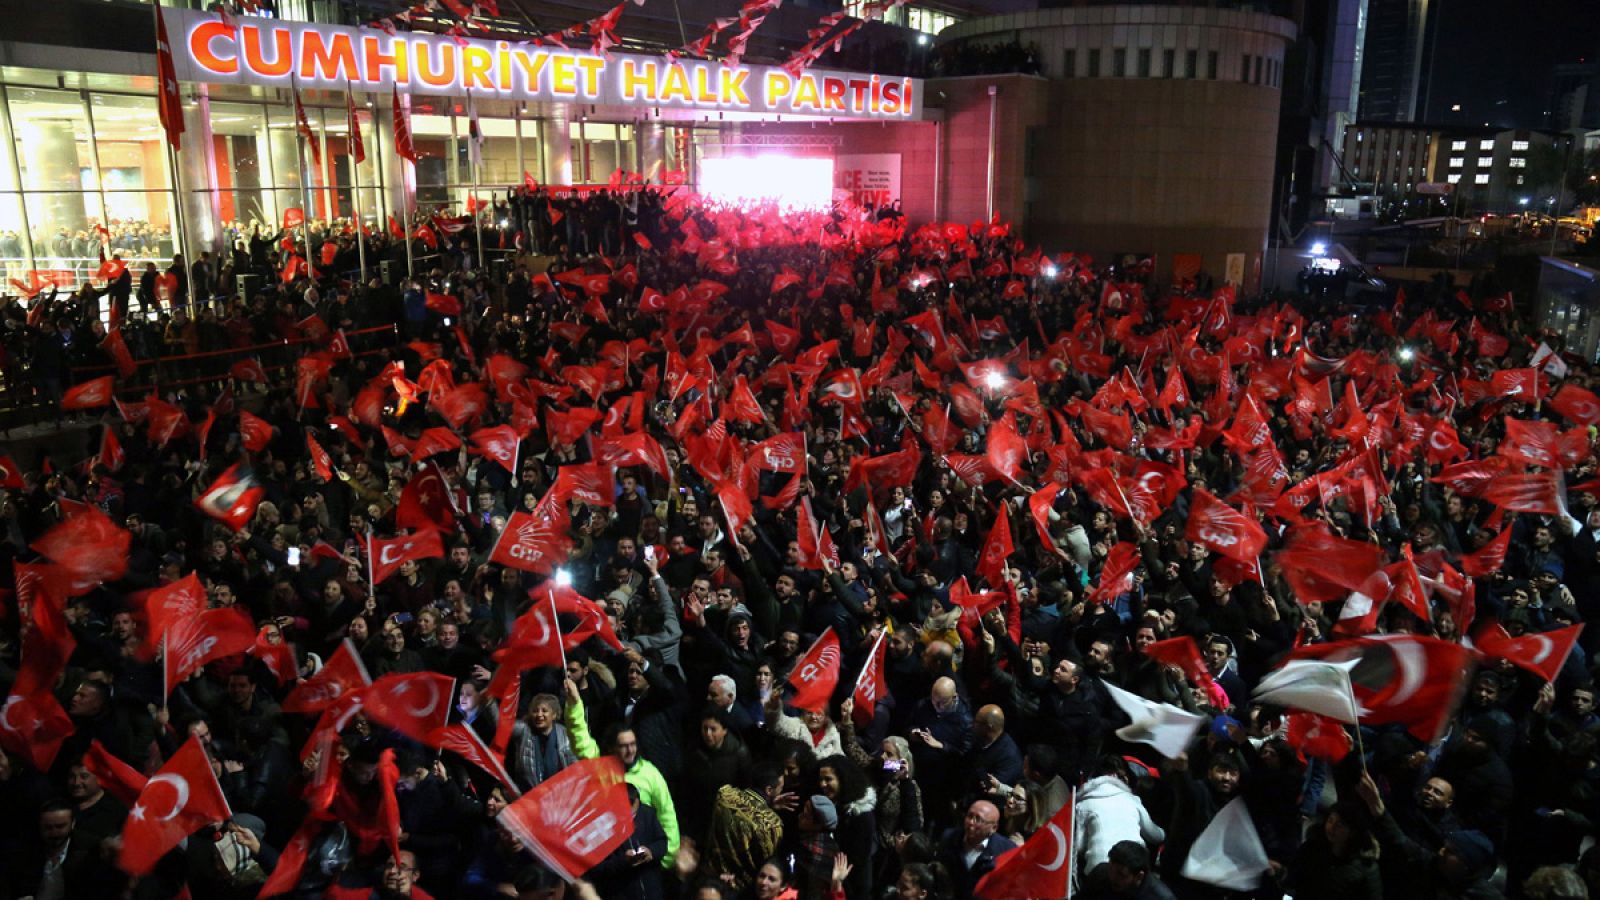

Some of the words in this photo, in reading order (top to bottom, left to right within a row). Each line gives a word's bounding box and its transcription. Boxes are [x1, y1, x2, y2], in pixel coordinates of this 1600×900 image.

[190, 20, 605, 96] CUMHURİYET
[621, 60, 751, 105] HALK
[766, 73, 913, 115] PARTİSİ
[509, 543, 544, 562] CHP
[176, 635, 219, 675] CHP
